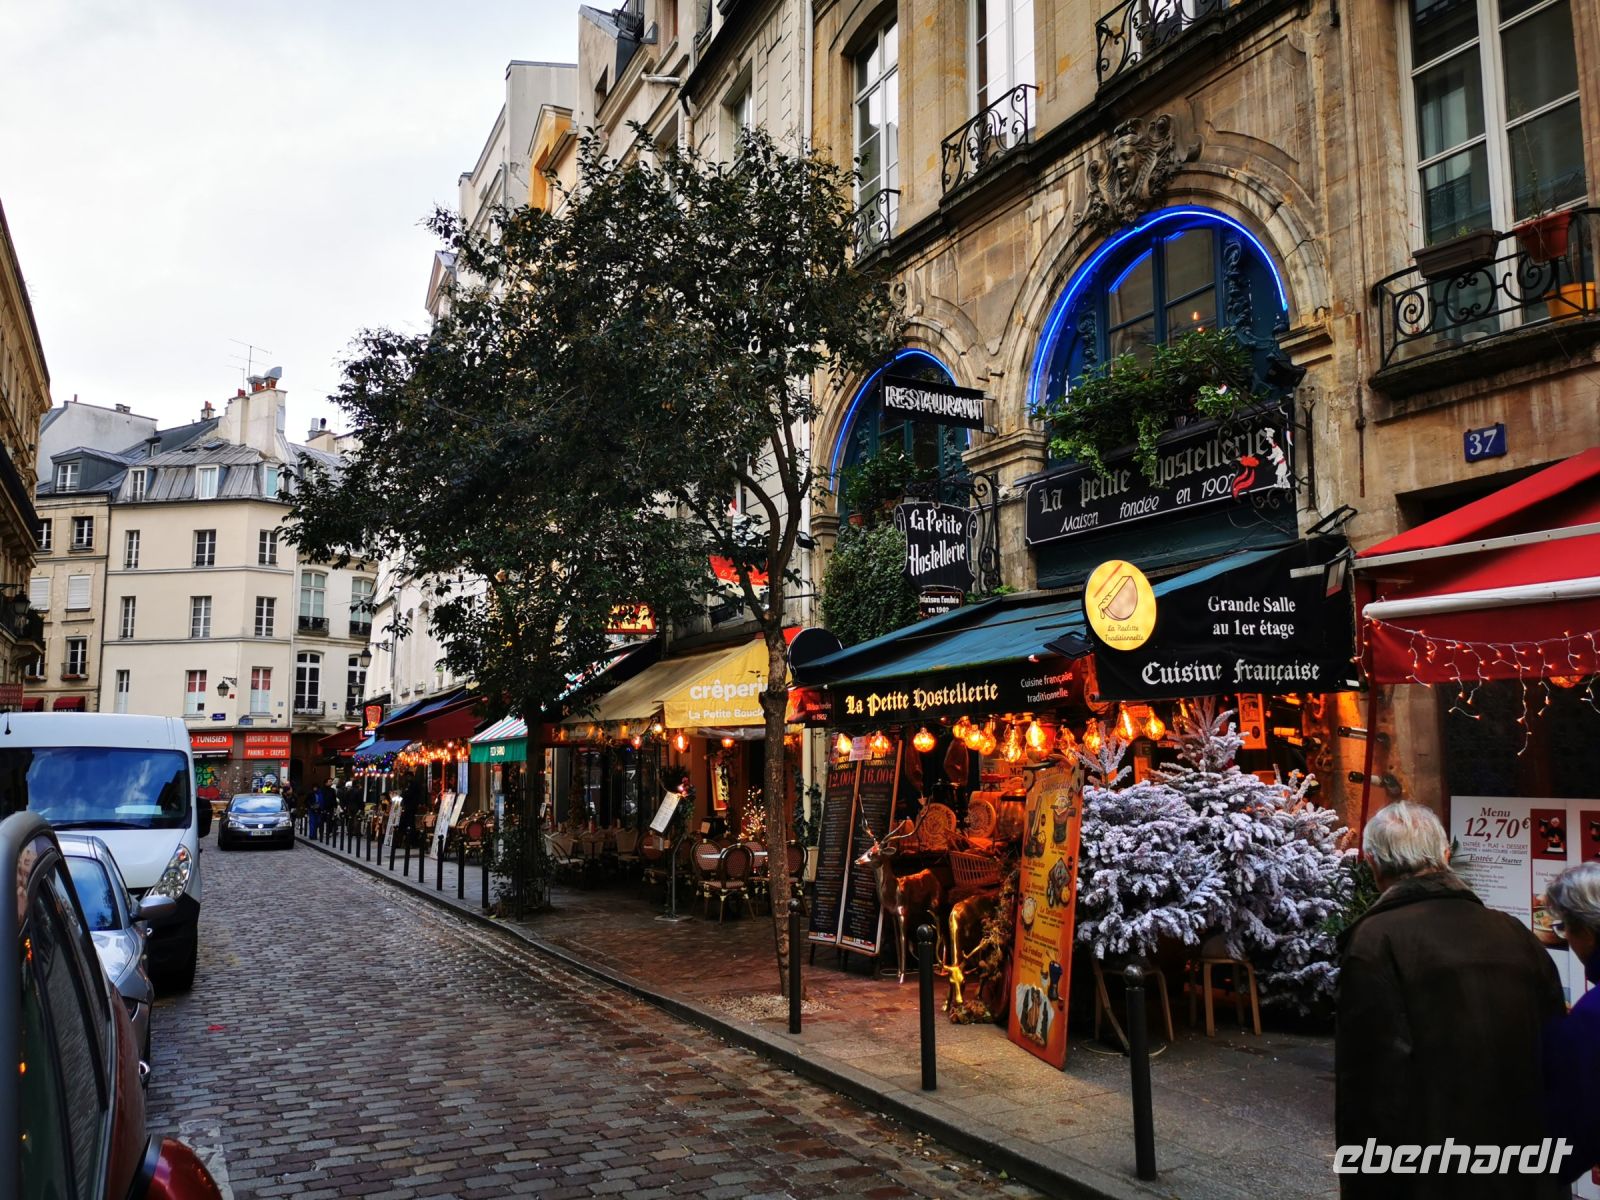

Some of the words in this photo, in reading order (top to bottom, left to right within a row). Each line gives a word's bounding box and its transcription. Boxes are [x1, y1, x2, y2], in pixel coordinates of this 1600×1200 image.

[885, 386, 984, 420] RESTAURANT
[1469, 429, 1498, 455] 37
[1039, 488, 1063, 513] La
[1060, 511, 1099, 532] Maison
[1119, 495, 1160, 518] fondée
[1176, 488, 1191, 504] en
[910, 509, 925, 531] La
[926, 509, 962, 535] Petite
[908, 540, 966, 577] Hostellerie
[1208, 596, 1260, 612] Grande
[1263, 597, 1296, 612] Salle
[1213, 622, 1229, 635] au
[1234, 620, 1256, 635] 1er
[1260, 620, 1295, 639] étage
[1020, 678, 1043, 688] Cuisine
[1142, 661, 1222, 685] Cuisine
[689, 678, 768, 702] crêperi
[688, 710, 700, 719] La
[703, 708, 732, 719] Petite
[845, 695, 864, 715] La
[866, 692, 910, 717] Petite
[246, 735, 268, 743] SANDWICH
[1480, 807, 1510, 817] Menu
[1470, 853, 1493, 862] Entrée
